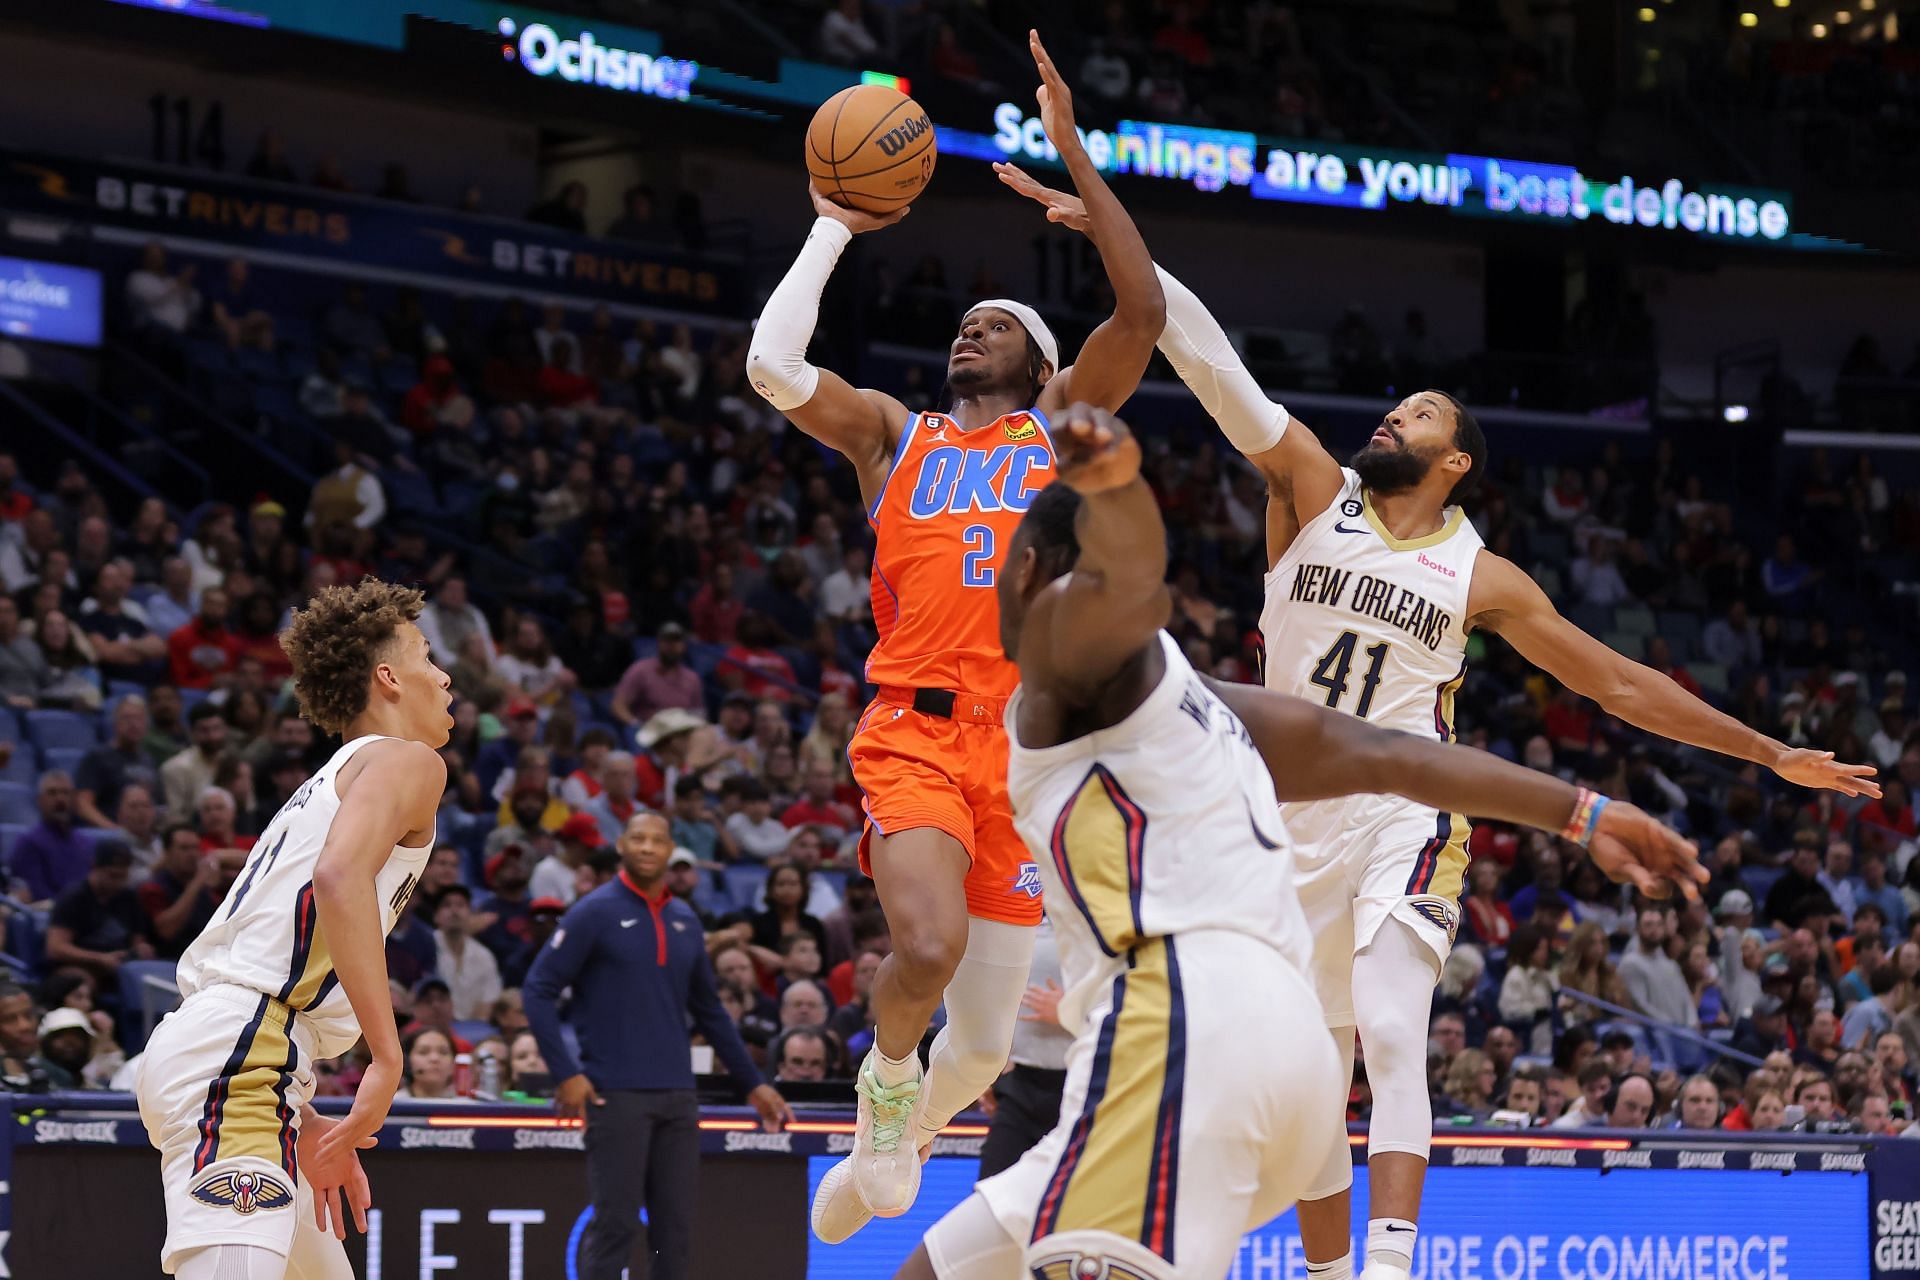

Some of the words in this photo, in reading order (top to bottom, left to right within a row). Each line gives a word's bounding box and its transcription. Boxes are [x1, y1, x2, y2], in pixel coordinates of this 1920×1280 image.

[994, 102, 1256, 192] Scenings
[1265, 148, 1348, 194] are
[1358, 157, 1472, 210] your
[1485, 158, 1590, 220] best
[1602, 175, 1789, 240] defense
[909, 445, 1050, 520] OKC
[1347, 501, 1362, 516] 6
[962, 524, 995, 588] 2
[1417, 552, 1456, 579] ibotta
[1289, 564, 1353, 607] NEW
[1351, 574, 1451, 651] ORLEANS
[1310, 629, 1391, 721] 41
[34, 1120, 118, 1144] SEATGEEK
[1493, 1235, 1550, 1280] OF
[1558, 1235, 1789, 1280] COMMERCE
[1874, 1235, 1920, 1272] GEE
